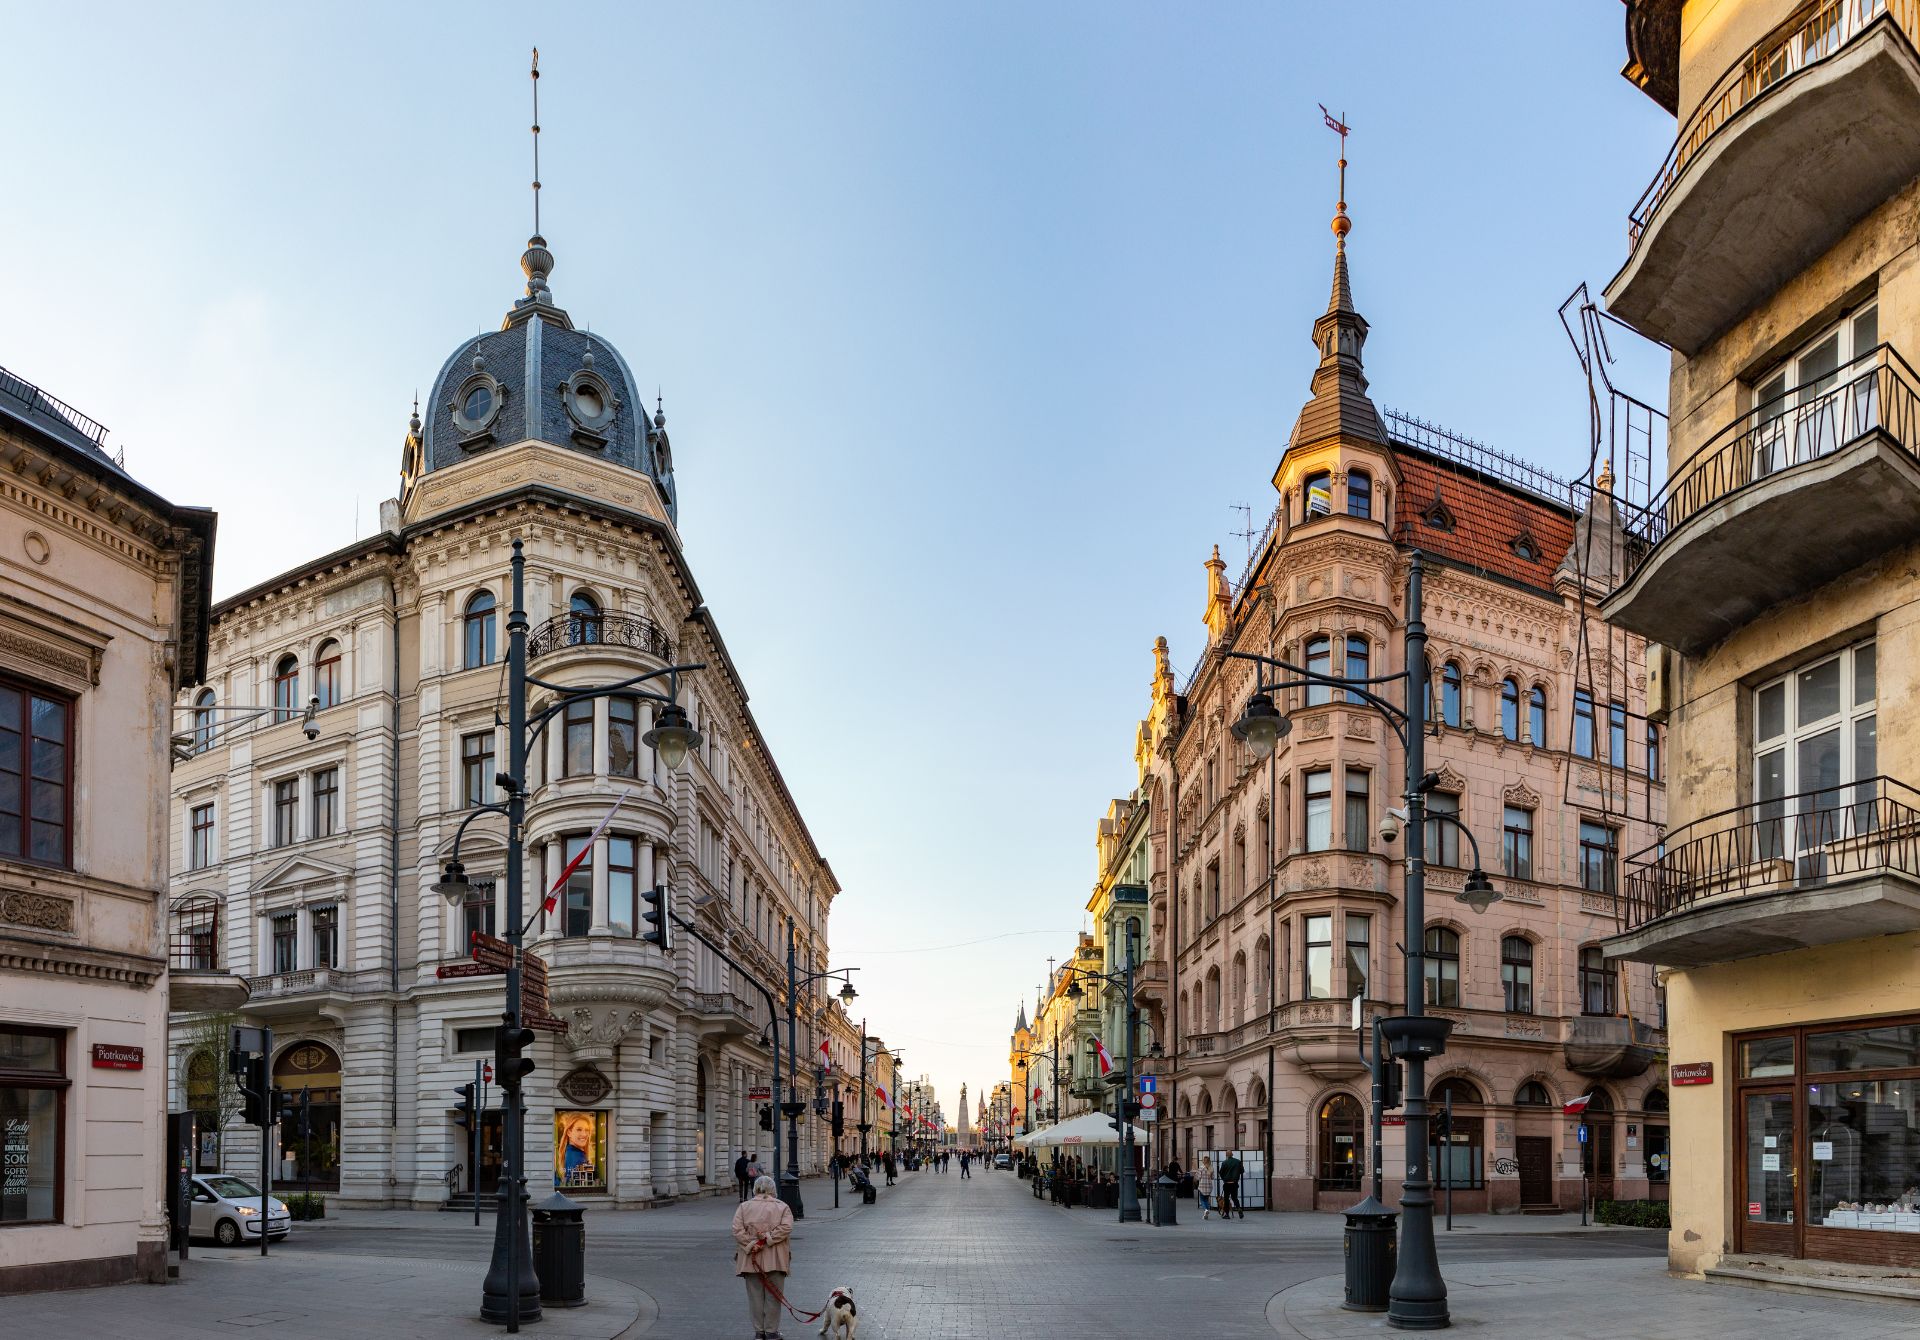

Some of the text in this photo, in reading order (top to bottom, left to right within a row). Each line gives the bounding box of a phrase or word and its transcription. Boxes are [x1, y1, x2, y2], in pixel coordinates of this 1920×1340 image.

[98, 1049, 140, 1062] Piotrkowska
[1673, 1067, 1707, 1079] Piotrkowska
[5, 1119, 30, 1135] Lody
[5, 1153, 30, 1165] SOKI
[4, 1167, 28, 1175] GOFRY
[4, 1187, 28, 1195] DESERY
